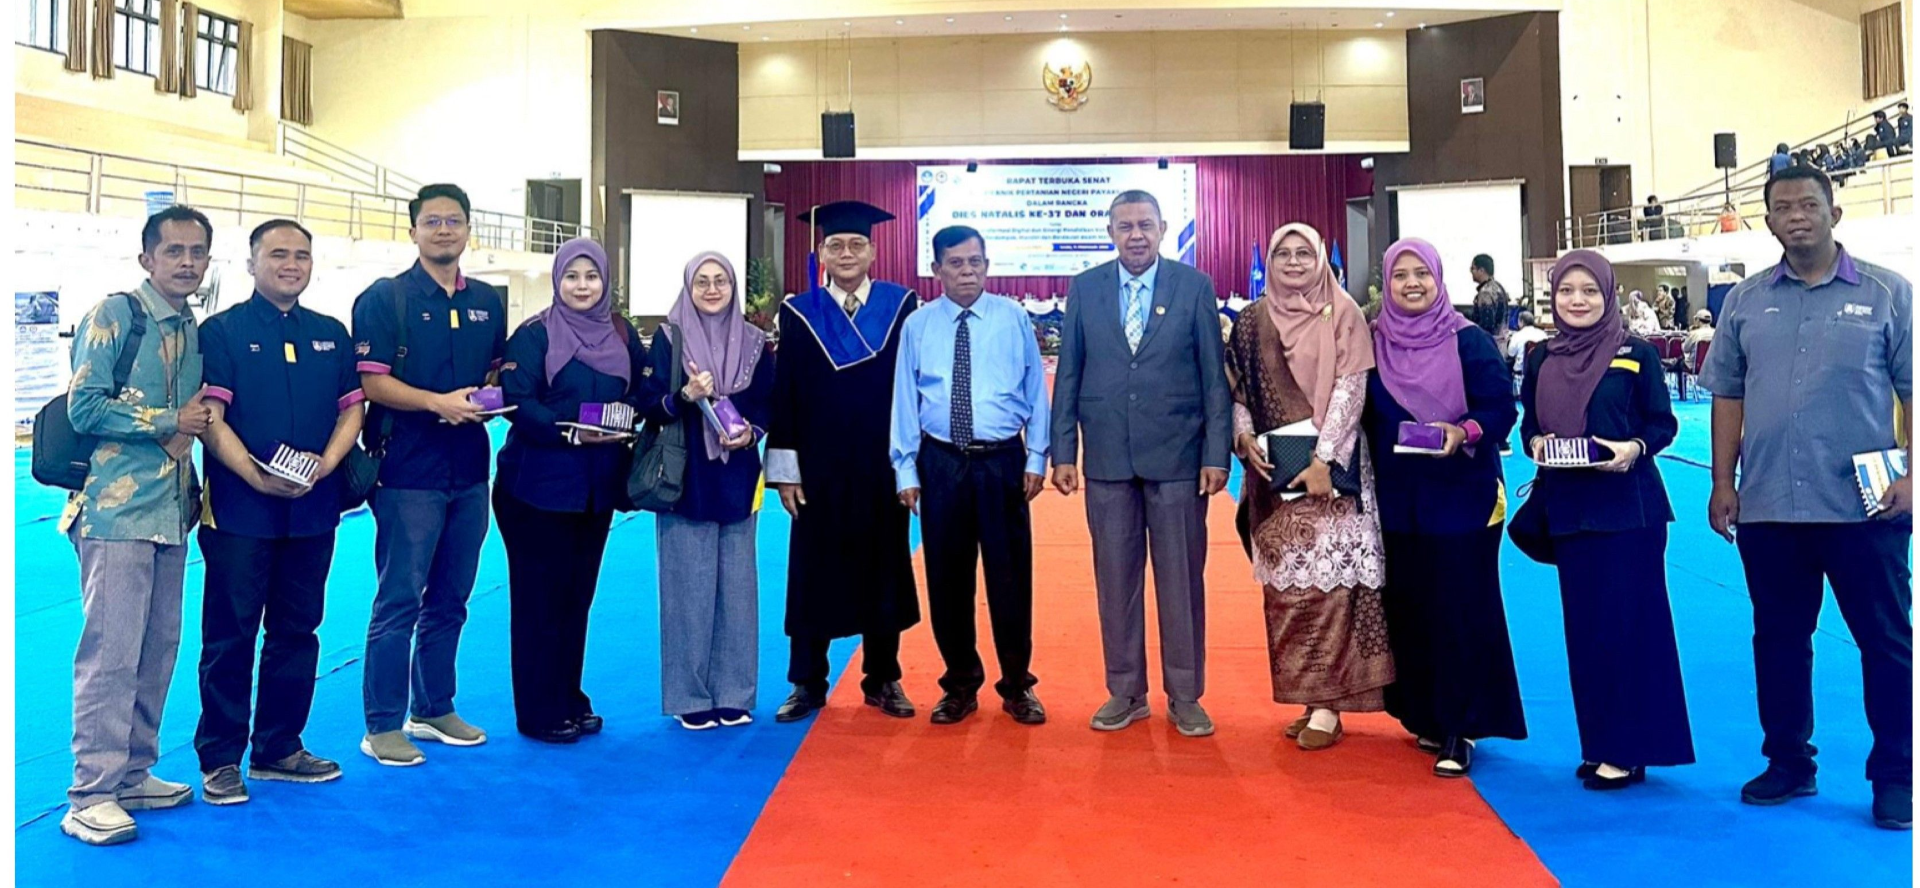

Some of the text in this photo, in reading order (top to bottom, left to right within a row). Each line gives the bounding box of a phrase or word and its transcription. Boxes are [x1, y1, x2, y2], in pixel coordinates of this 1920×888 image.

[1082, 176, 1111, 184] SENAT
[952, 210, 1110, 219] DIES NATALIS KE-37 DAN ORA
